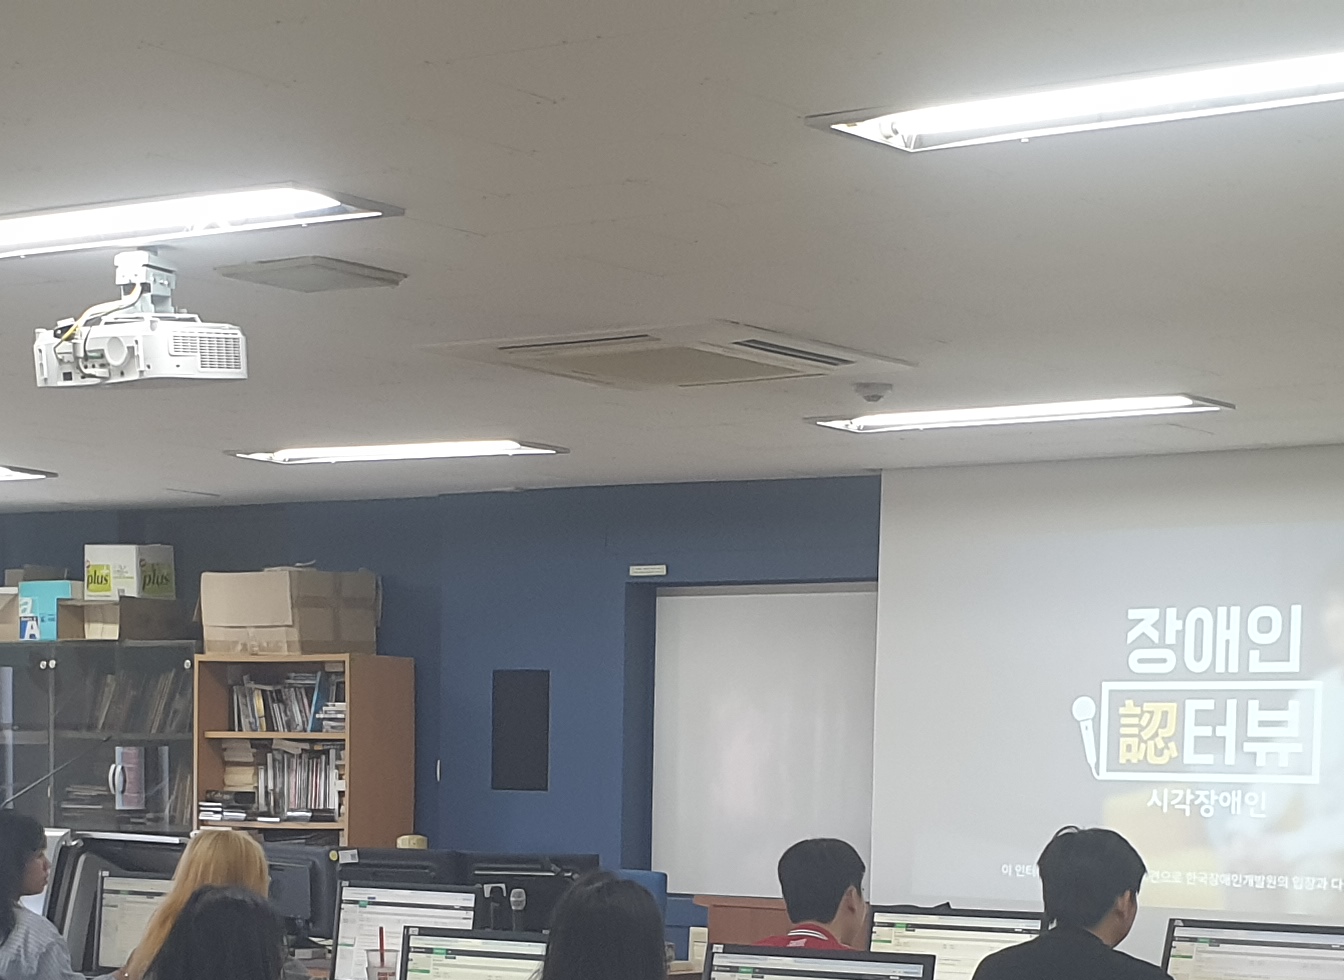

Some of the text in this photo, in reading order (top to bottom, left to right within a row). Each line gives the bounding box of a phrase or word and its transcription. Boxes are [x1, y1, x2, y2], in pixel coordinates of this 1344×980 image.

[87, 569, 109, 590] plus
[1126, 604, 1302, 674] 장애인
[1118, 698, 1304, 767] 認터뷰
[1146, 787, 1267, 818] 시각장애인
[1001, 863, 1012, 877] 이
